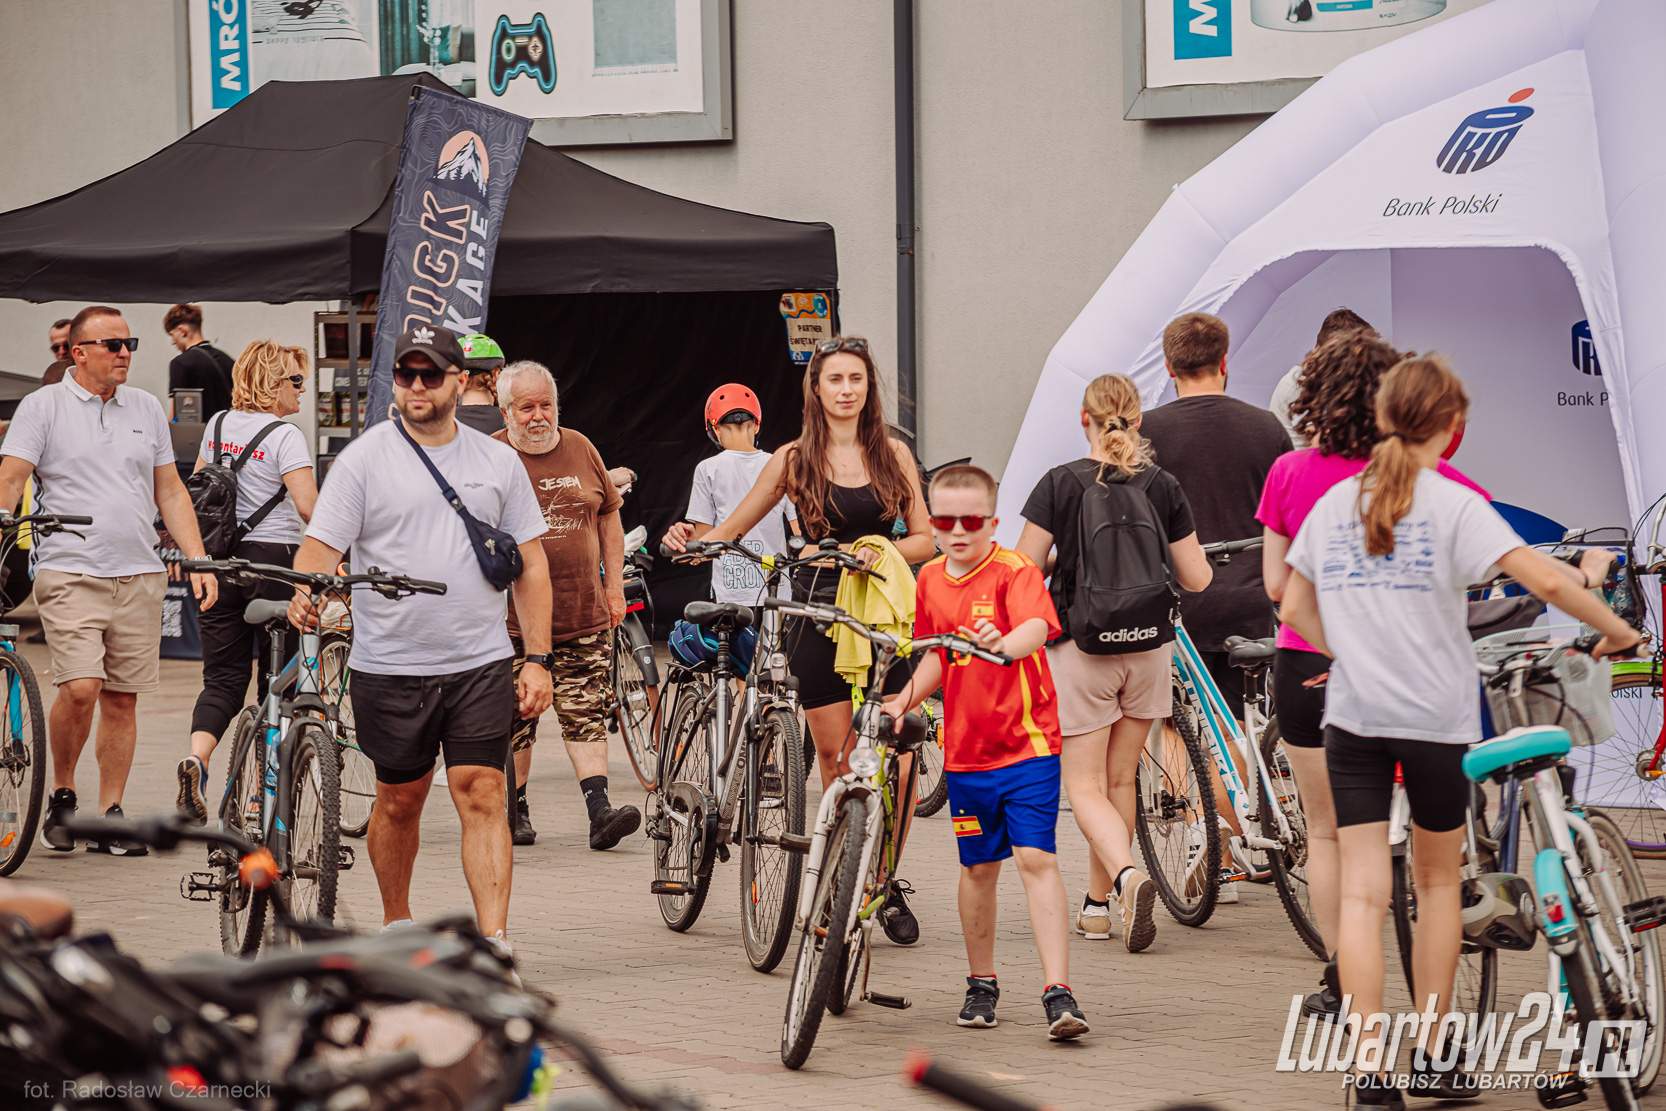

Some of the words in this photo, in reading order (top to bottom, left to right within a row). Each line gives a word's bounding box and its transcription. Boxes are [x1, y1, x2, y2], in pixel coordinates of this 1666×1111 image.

[1383, 196, 1436, 217] Bank
[1439, 193, 1503, 216] Polski
[1557, 391, 1595, 406] Bank
[538, 475, 582, 491] JESTEM
[1098, 626, 1158, 642] adidas
